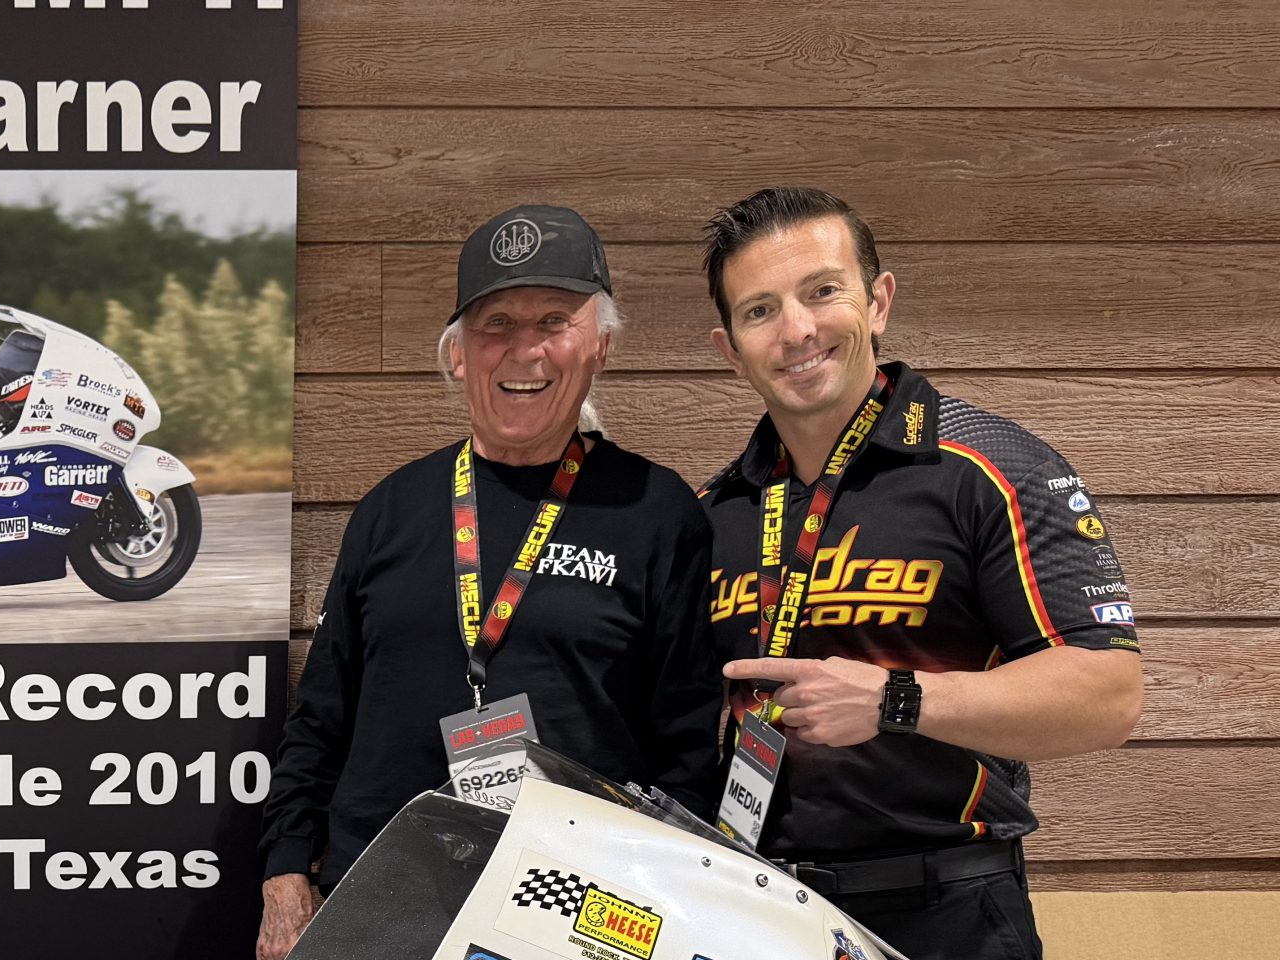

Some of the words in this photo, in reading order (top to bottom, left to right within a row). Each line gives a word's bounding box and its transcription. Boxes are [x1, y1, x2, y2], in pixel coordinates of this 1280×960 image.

[77, 374, 121, 396] Brock's
[67, 396, 111, 416] VORTEX
[56, 423, 99, 443] SPIEGLER
[826, 399, 883, 475] MECUM
[45, 465, 109, 486] Garrett
[513, 503, 561, 571] MECUM
[762, 484, 785, 567] MECUM
[536, 558, 618, 587] FKAWI
[546, 543, 616, 568] TEAM
[460, 572, 480, 647] MECUM
[769, 572, 807, 657] MECUM
[88, 751, 271, 805] 2010
[728, 779, 763, 820] MEDIA
[588, 893, 657, 923] JOHNNY
[578, 923, 648, 957] PERFORMANCE
